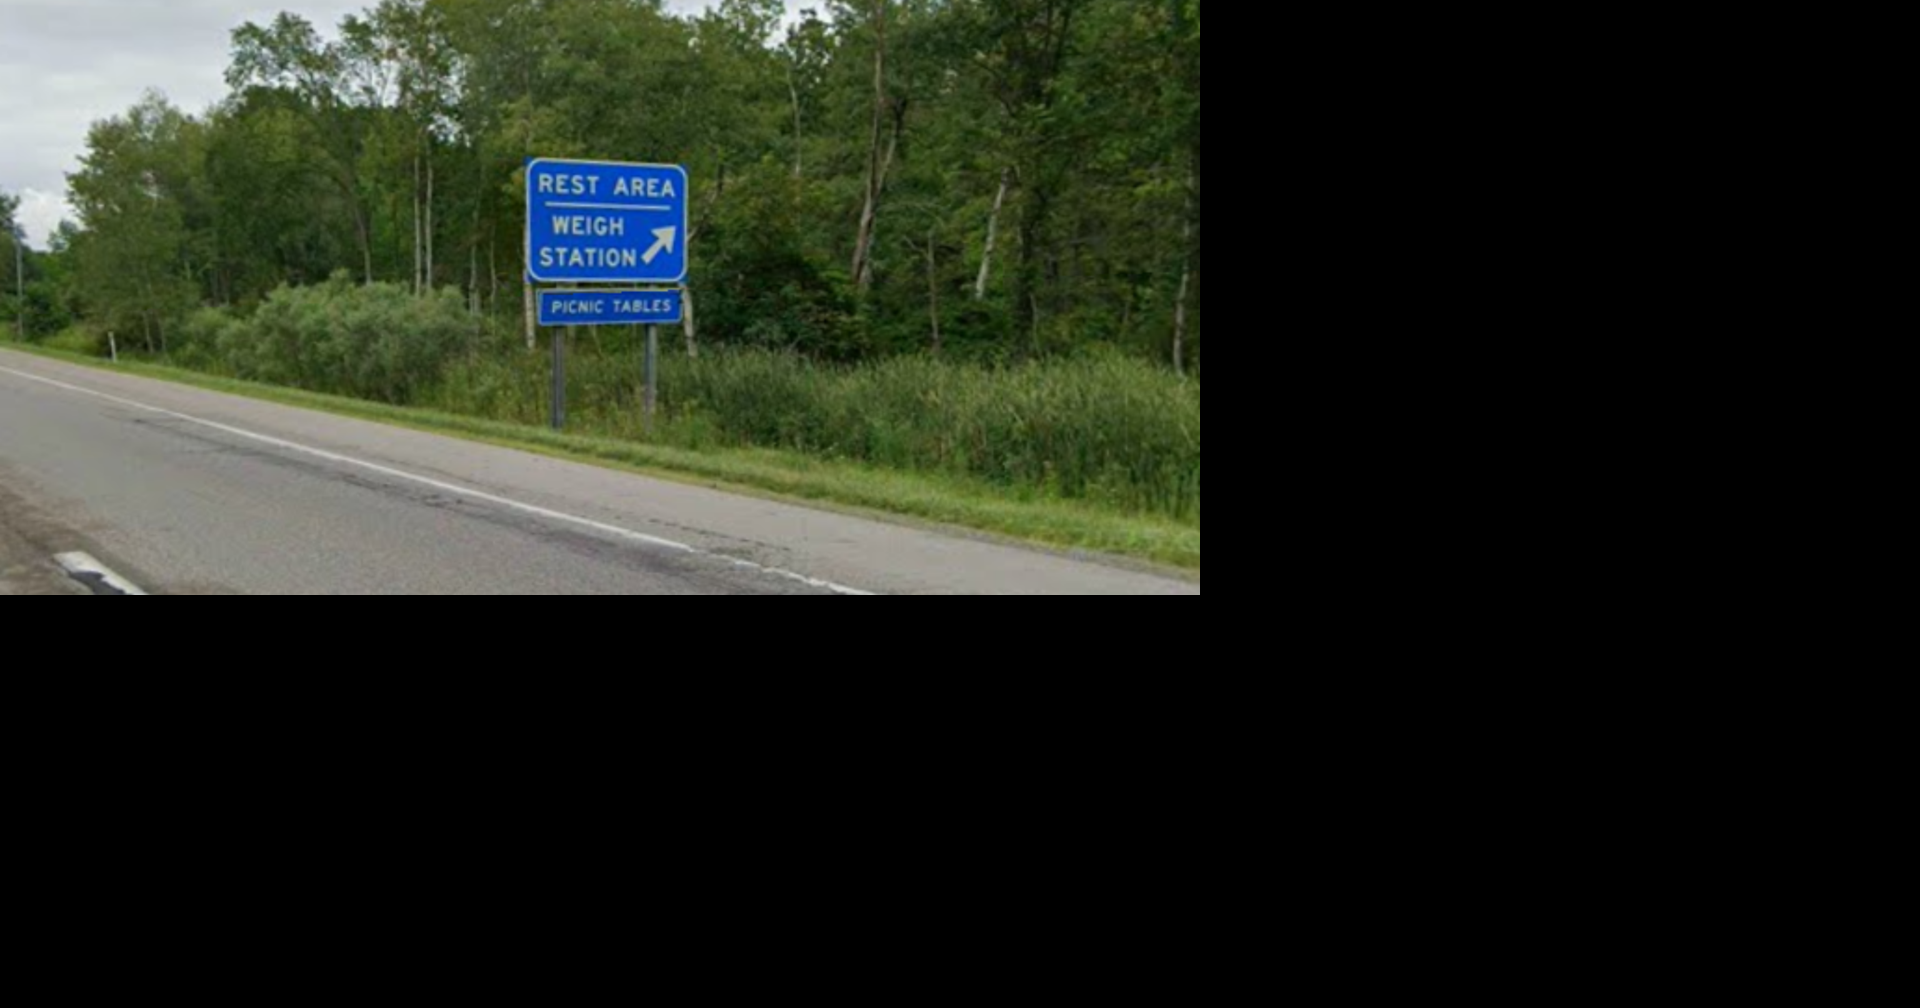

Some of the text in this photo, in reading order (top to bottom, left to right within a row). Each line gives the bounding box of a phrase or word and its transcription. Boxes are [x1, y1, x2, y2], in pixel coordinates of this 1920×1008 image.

[538, 173, 675, 198] REST AREA
[552, 215, 624, 236] WEIGH
[539, 247, 637, 267] STATION
[552, 299, 671, 314] PICNIC TABLES
